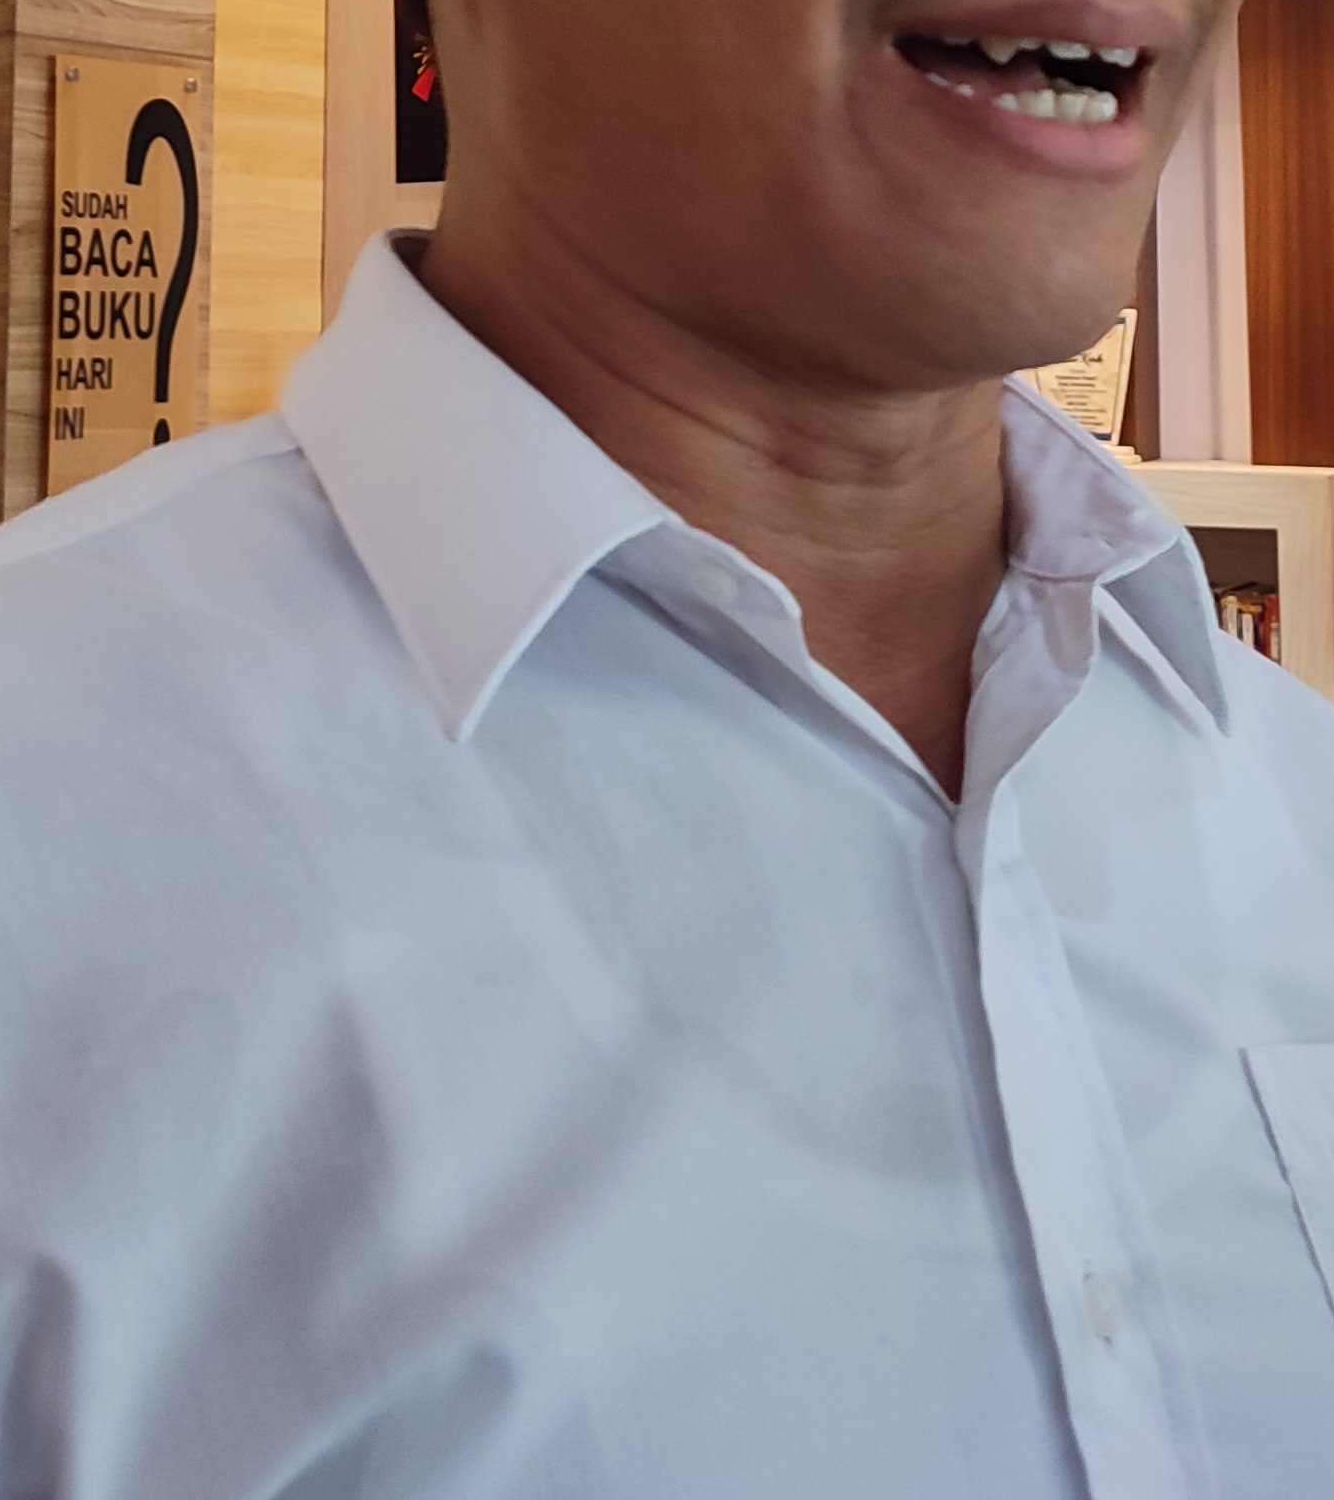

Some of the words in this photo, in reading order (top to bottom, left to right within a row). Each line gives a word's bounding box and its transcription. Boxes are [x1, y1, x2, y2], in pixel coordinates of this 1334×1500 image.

[61, 190, 128, 219] SUDAH
[59, 226, 158, 278] BACA
[57, 290, 156, 340] BUKU
[56, 357, 113, 390] HARI
[54, 405, 85, 440] INI
